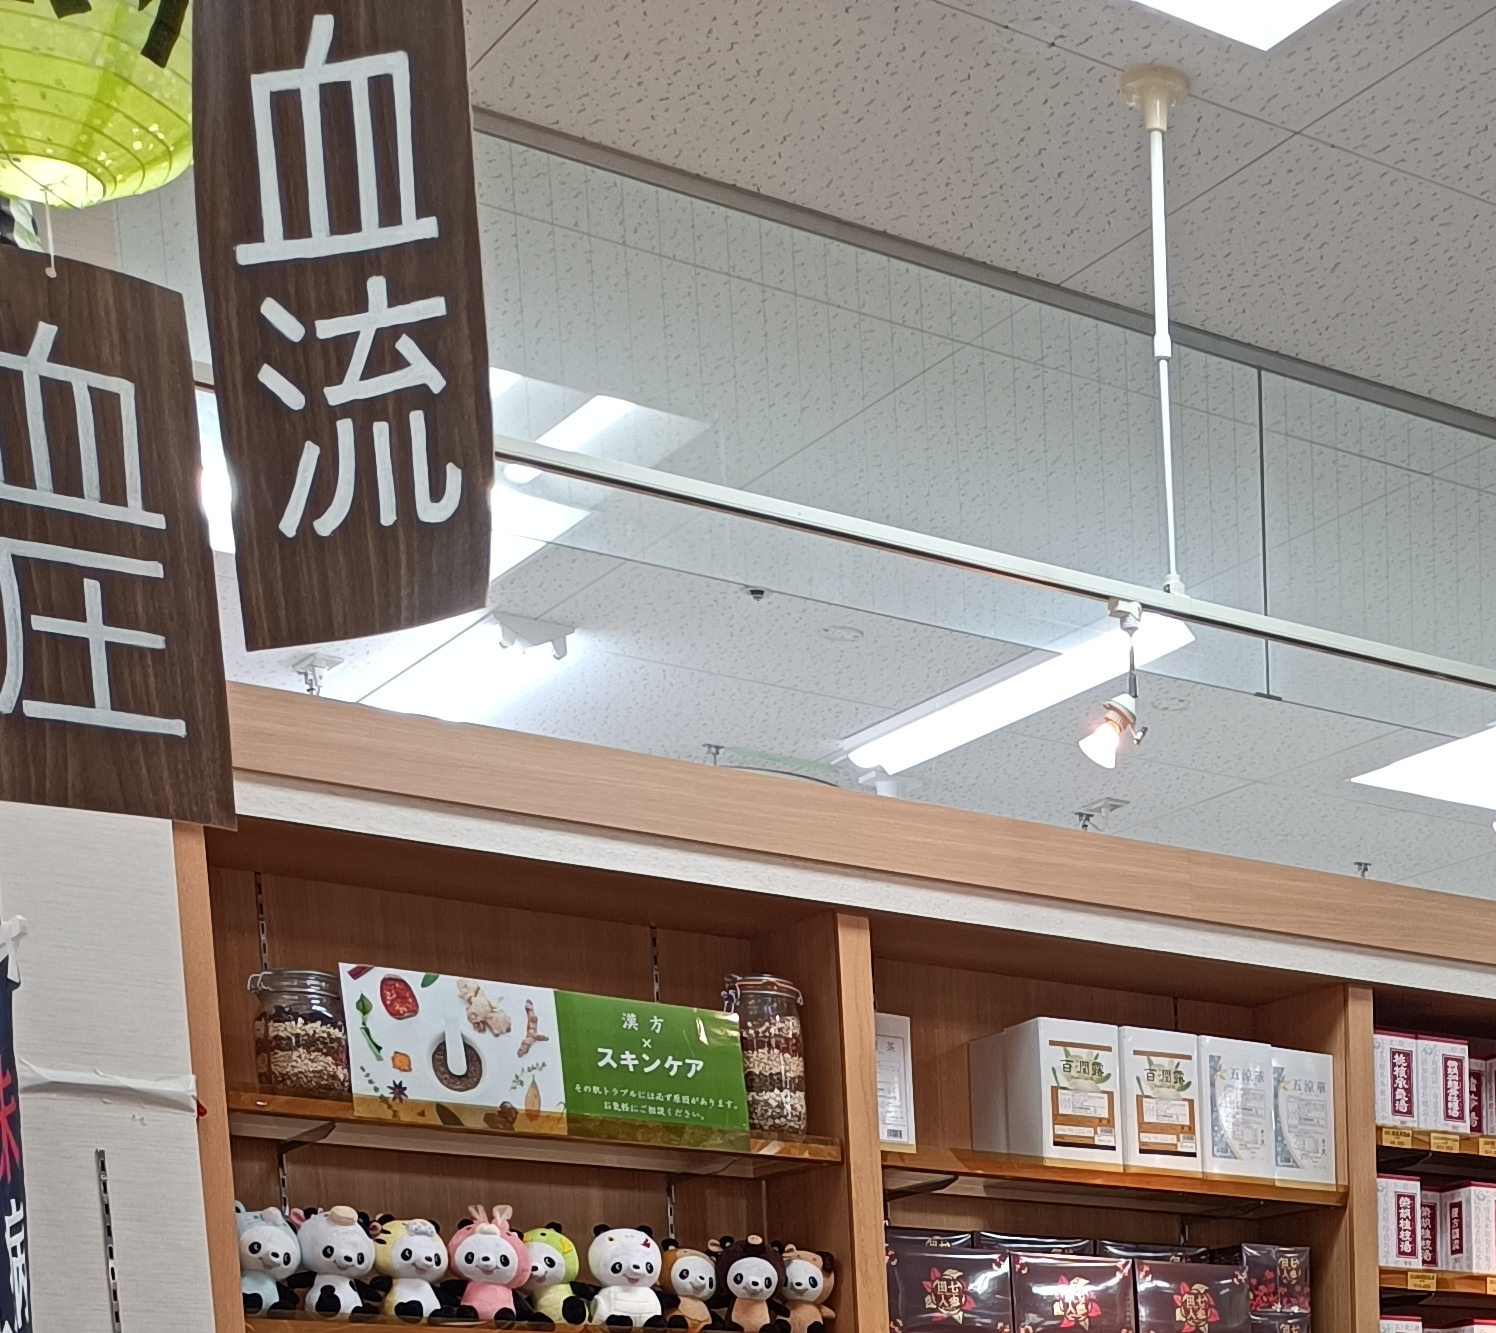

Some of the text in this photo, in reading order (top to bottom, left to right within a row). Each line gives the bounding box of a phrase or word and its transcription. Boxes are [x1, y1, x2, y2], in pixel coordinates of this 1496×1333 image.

[235, 14, 463, 538] 血流
[0, 322, 187, 738] 血圧
[597, 1047, 704, 1078] スキンケア
